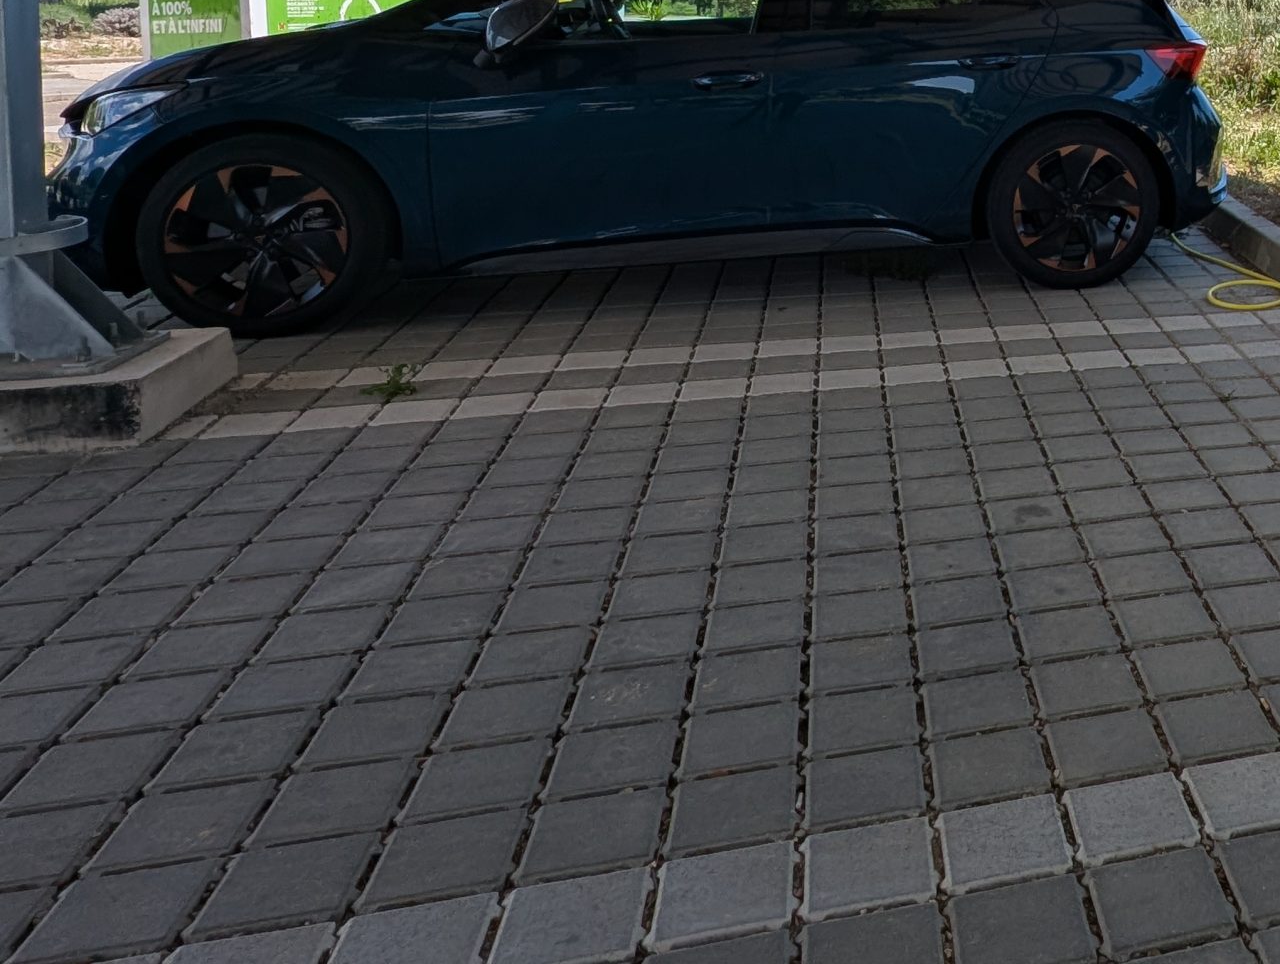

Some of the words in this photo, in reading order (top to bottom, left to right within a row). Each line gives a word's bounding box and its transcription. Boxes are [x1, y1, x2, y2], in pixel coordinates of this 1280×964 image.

[152, 0, 160, 15] À
[161, 0, 192, 15] 100%
[152, 19, 166, 34] ET
[168, 16, 177, 34] À
[178, 18, 222, 34] L'INFINI
